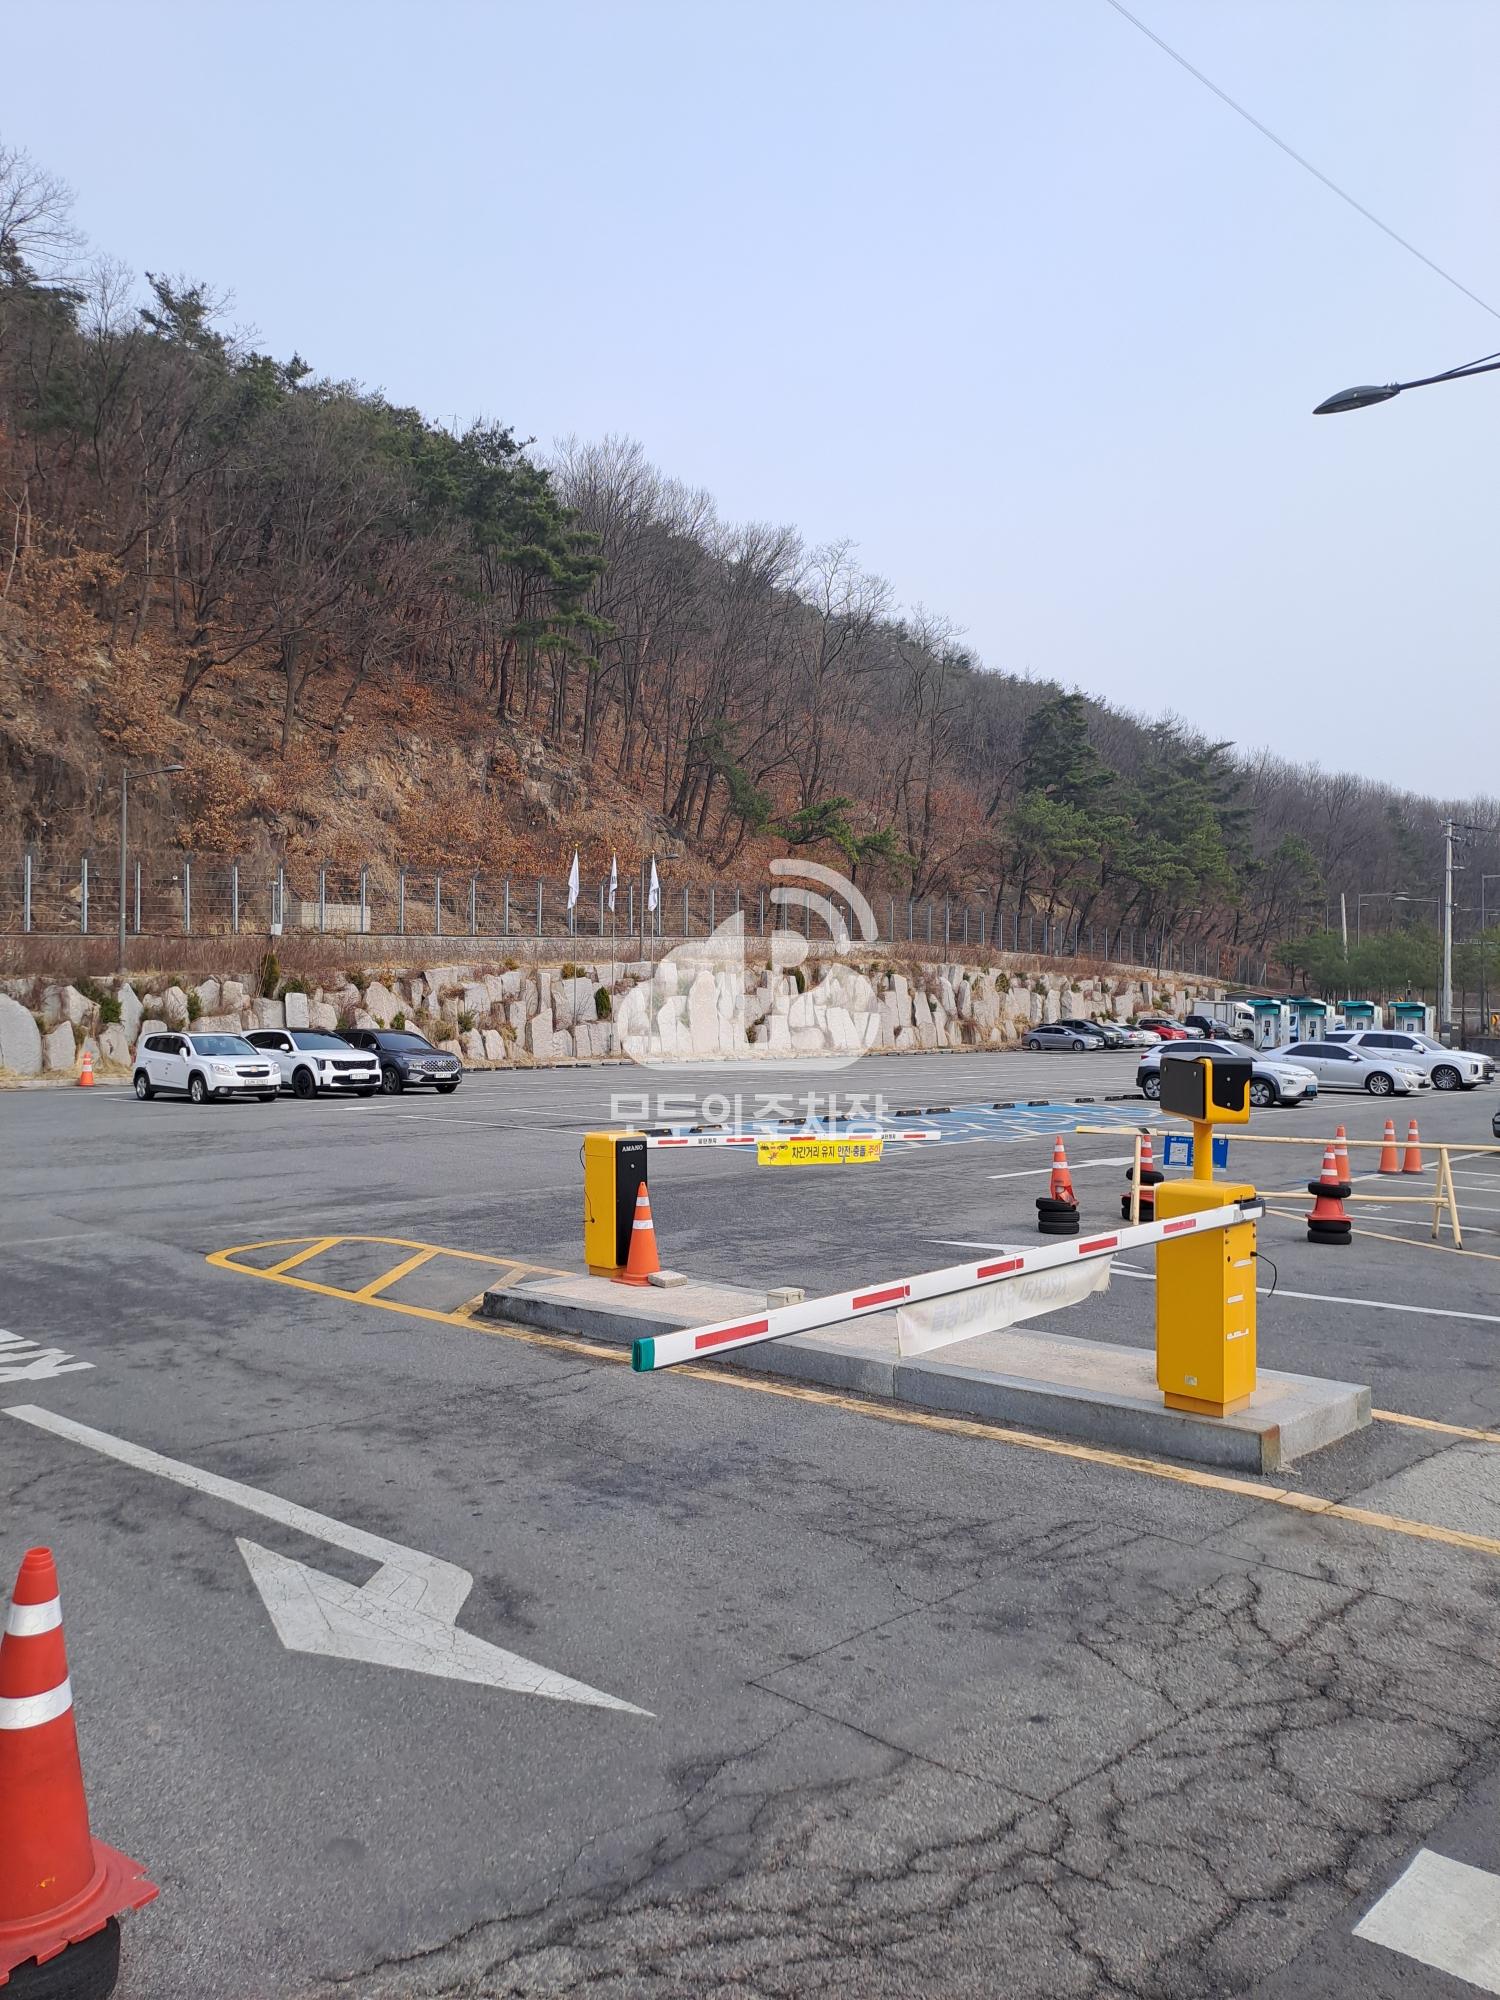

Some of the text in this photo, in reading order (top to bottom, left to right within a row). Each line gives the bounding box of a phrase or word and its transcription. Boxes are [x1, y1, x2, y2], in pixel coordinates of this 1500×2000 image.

[622, 1144, 643, 1152] AMANO
[792, 1146, 819, 1159] 차간거리
[822, 1146, 834, 1158] 유지
[868, 1144, 880, 1156] 주의
